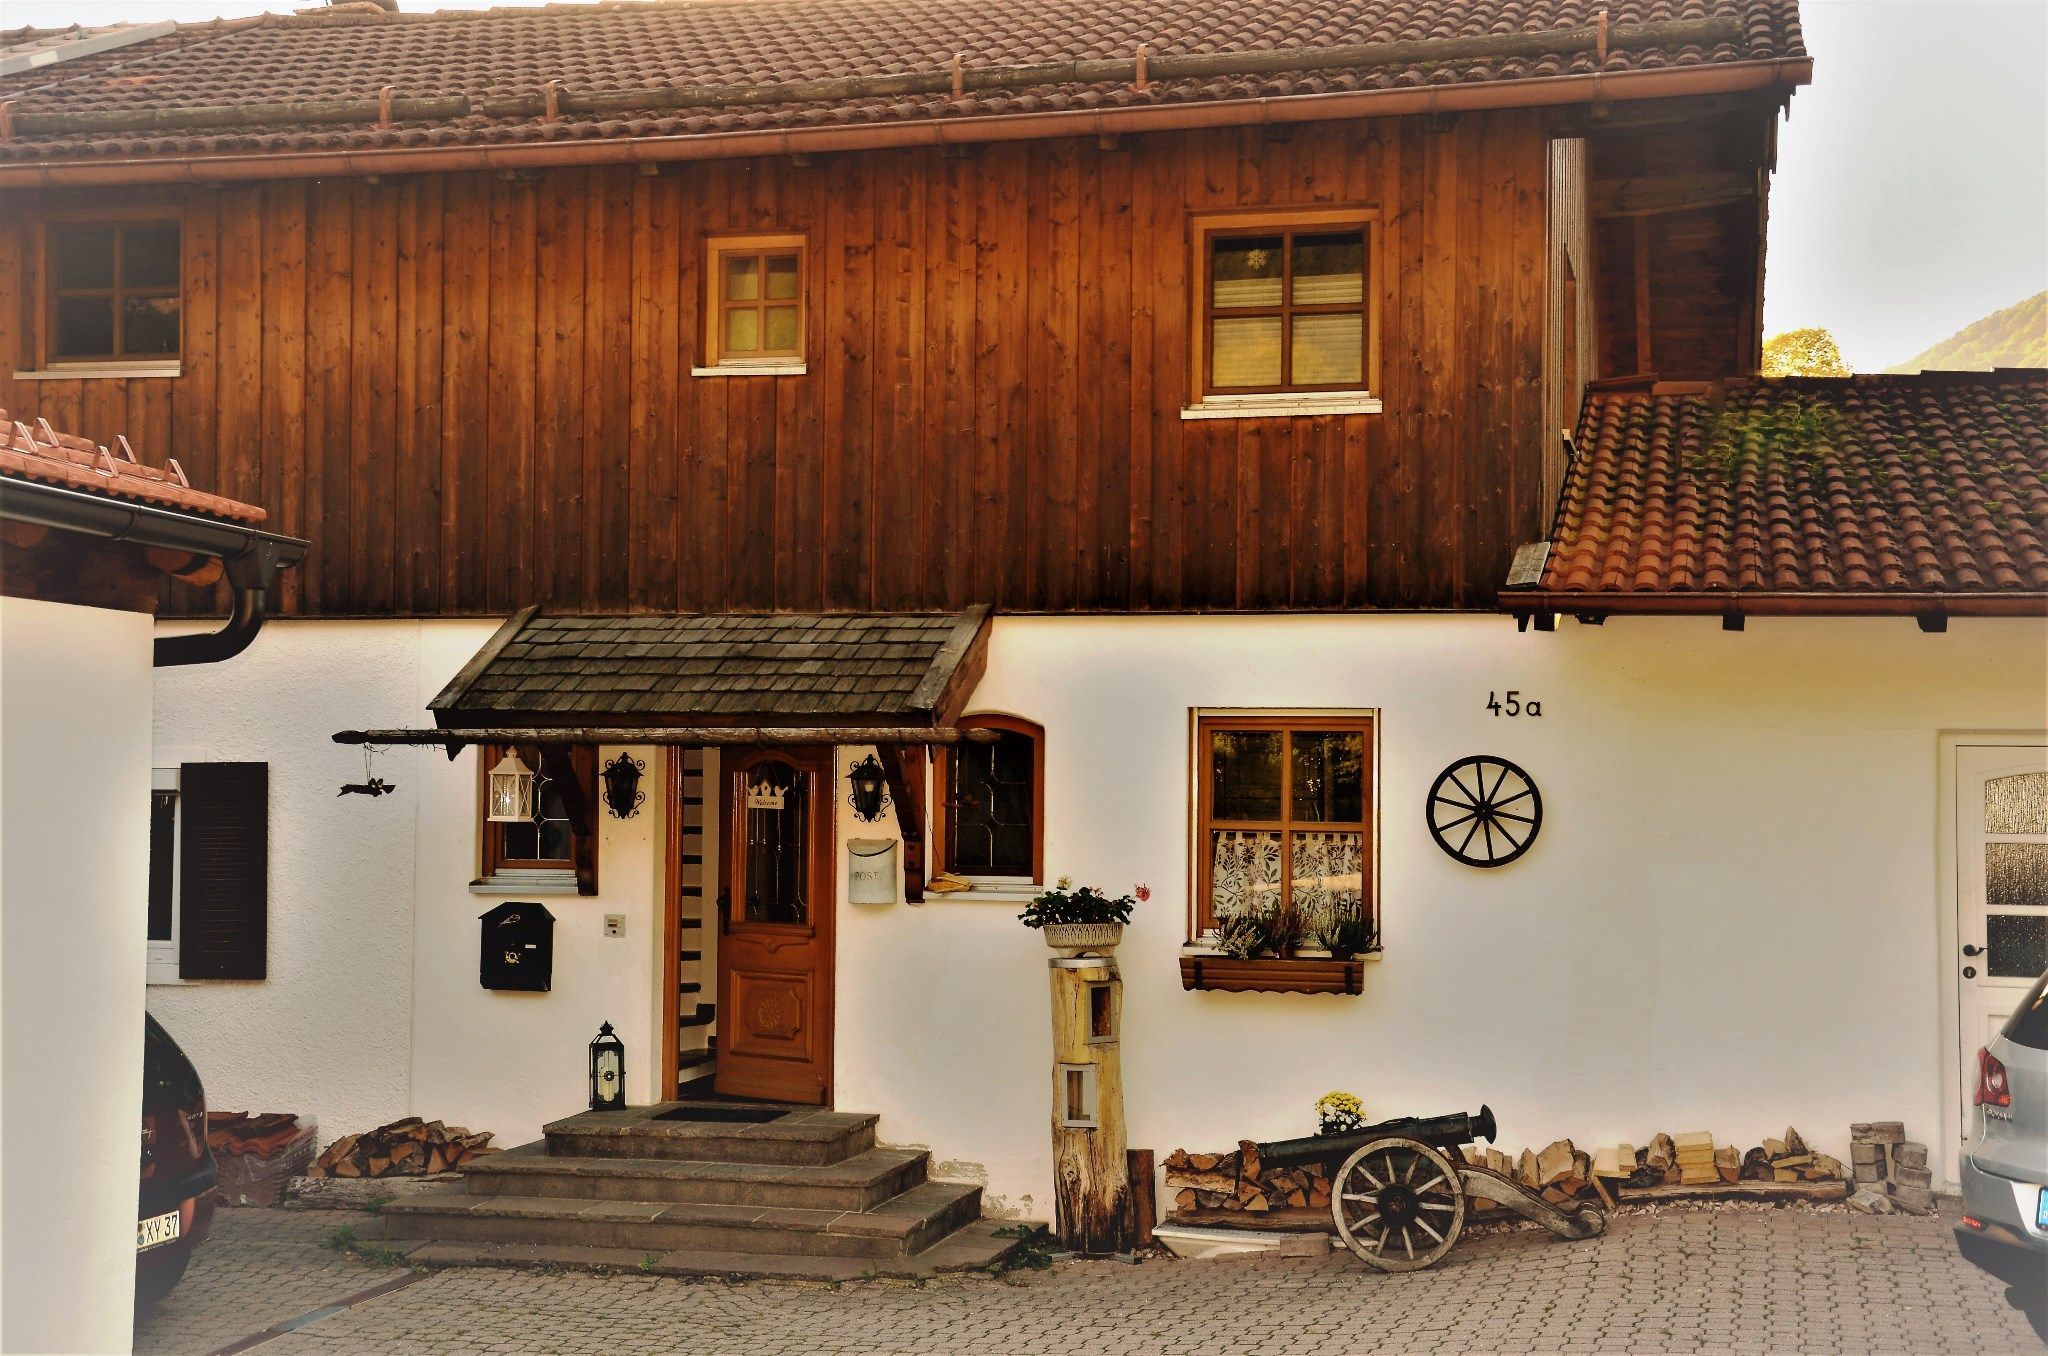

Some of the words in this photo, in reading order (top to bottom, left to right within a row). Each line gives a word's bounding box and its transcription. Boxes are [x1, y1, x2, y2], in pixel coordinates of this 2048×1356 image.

[1486, 690, 1542, 717] 45a
[854, 871, 880, 881] POST
[146, 1219, 161, 1243] XY
[164, 1214, 178, 1237] 37
